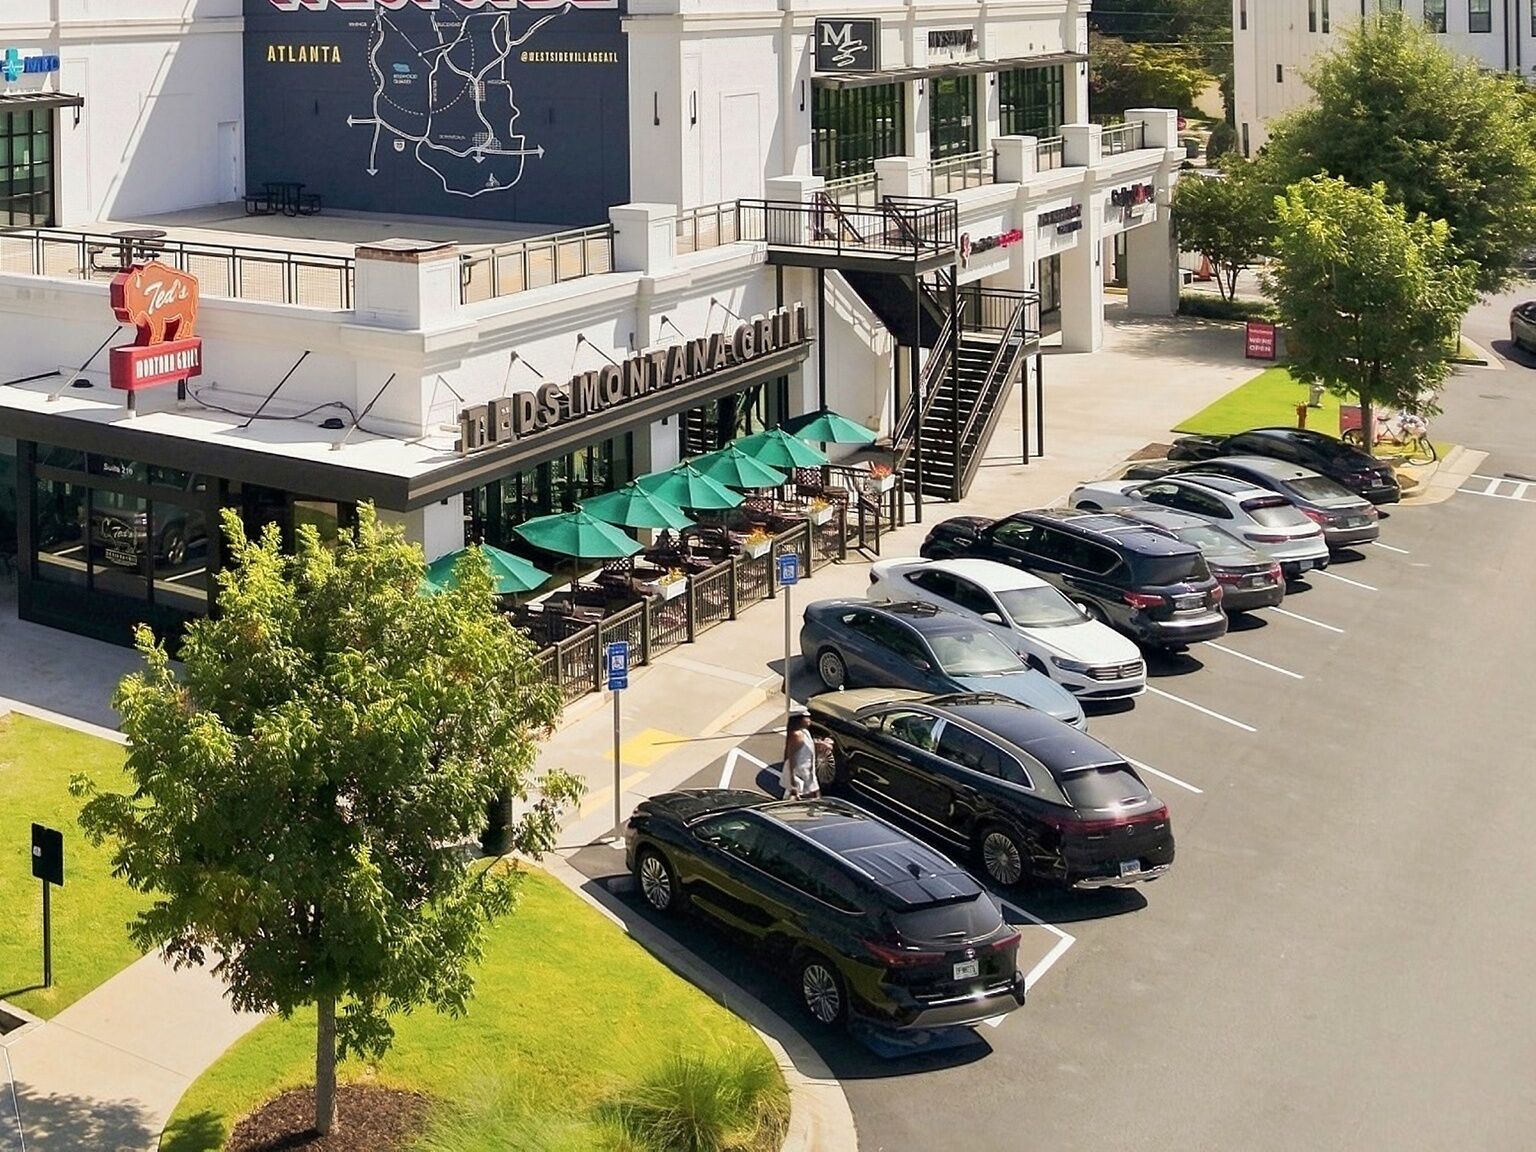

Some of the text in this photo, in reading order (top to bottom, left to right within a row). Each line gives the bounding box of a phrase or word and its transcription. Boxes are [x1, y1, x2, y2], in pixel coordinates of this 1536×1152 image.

[24, 55, 60, 74] MED
[267, 45, 342, 63] ATLANTA
[520, 51, 619, 62] @WESTSIDEVILLAGEATL
[143, 279, 189, 315] Ted's
[136, 348, 199, 379] MONTANA GRILL
[568, 332, 727, 418] MONTANA
